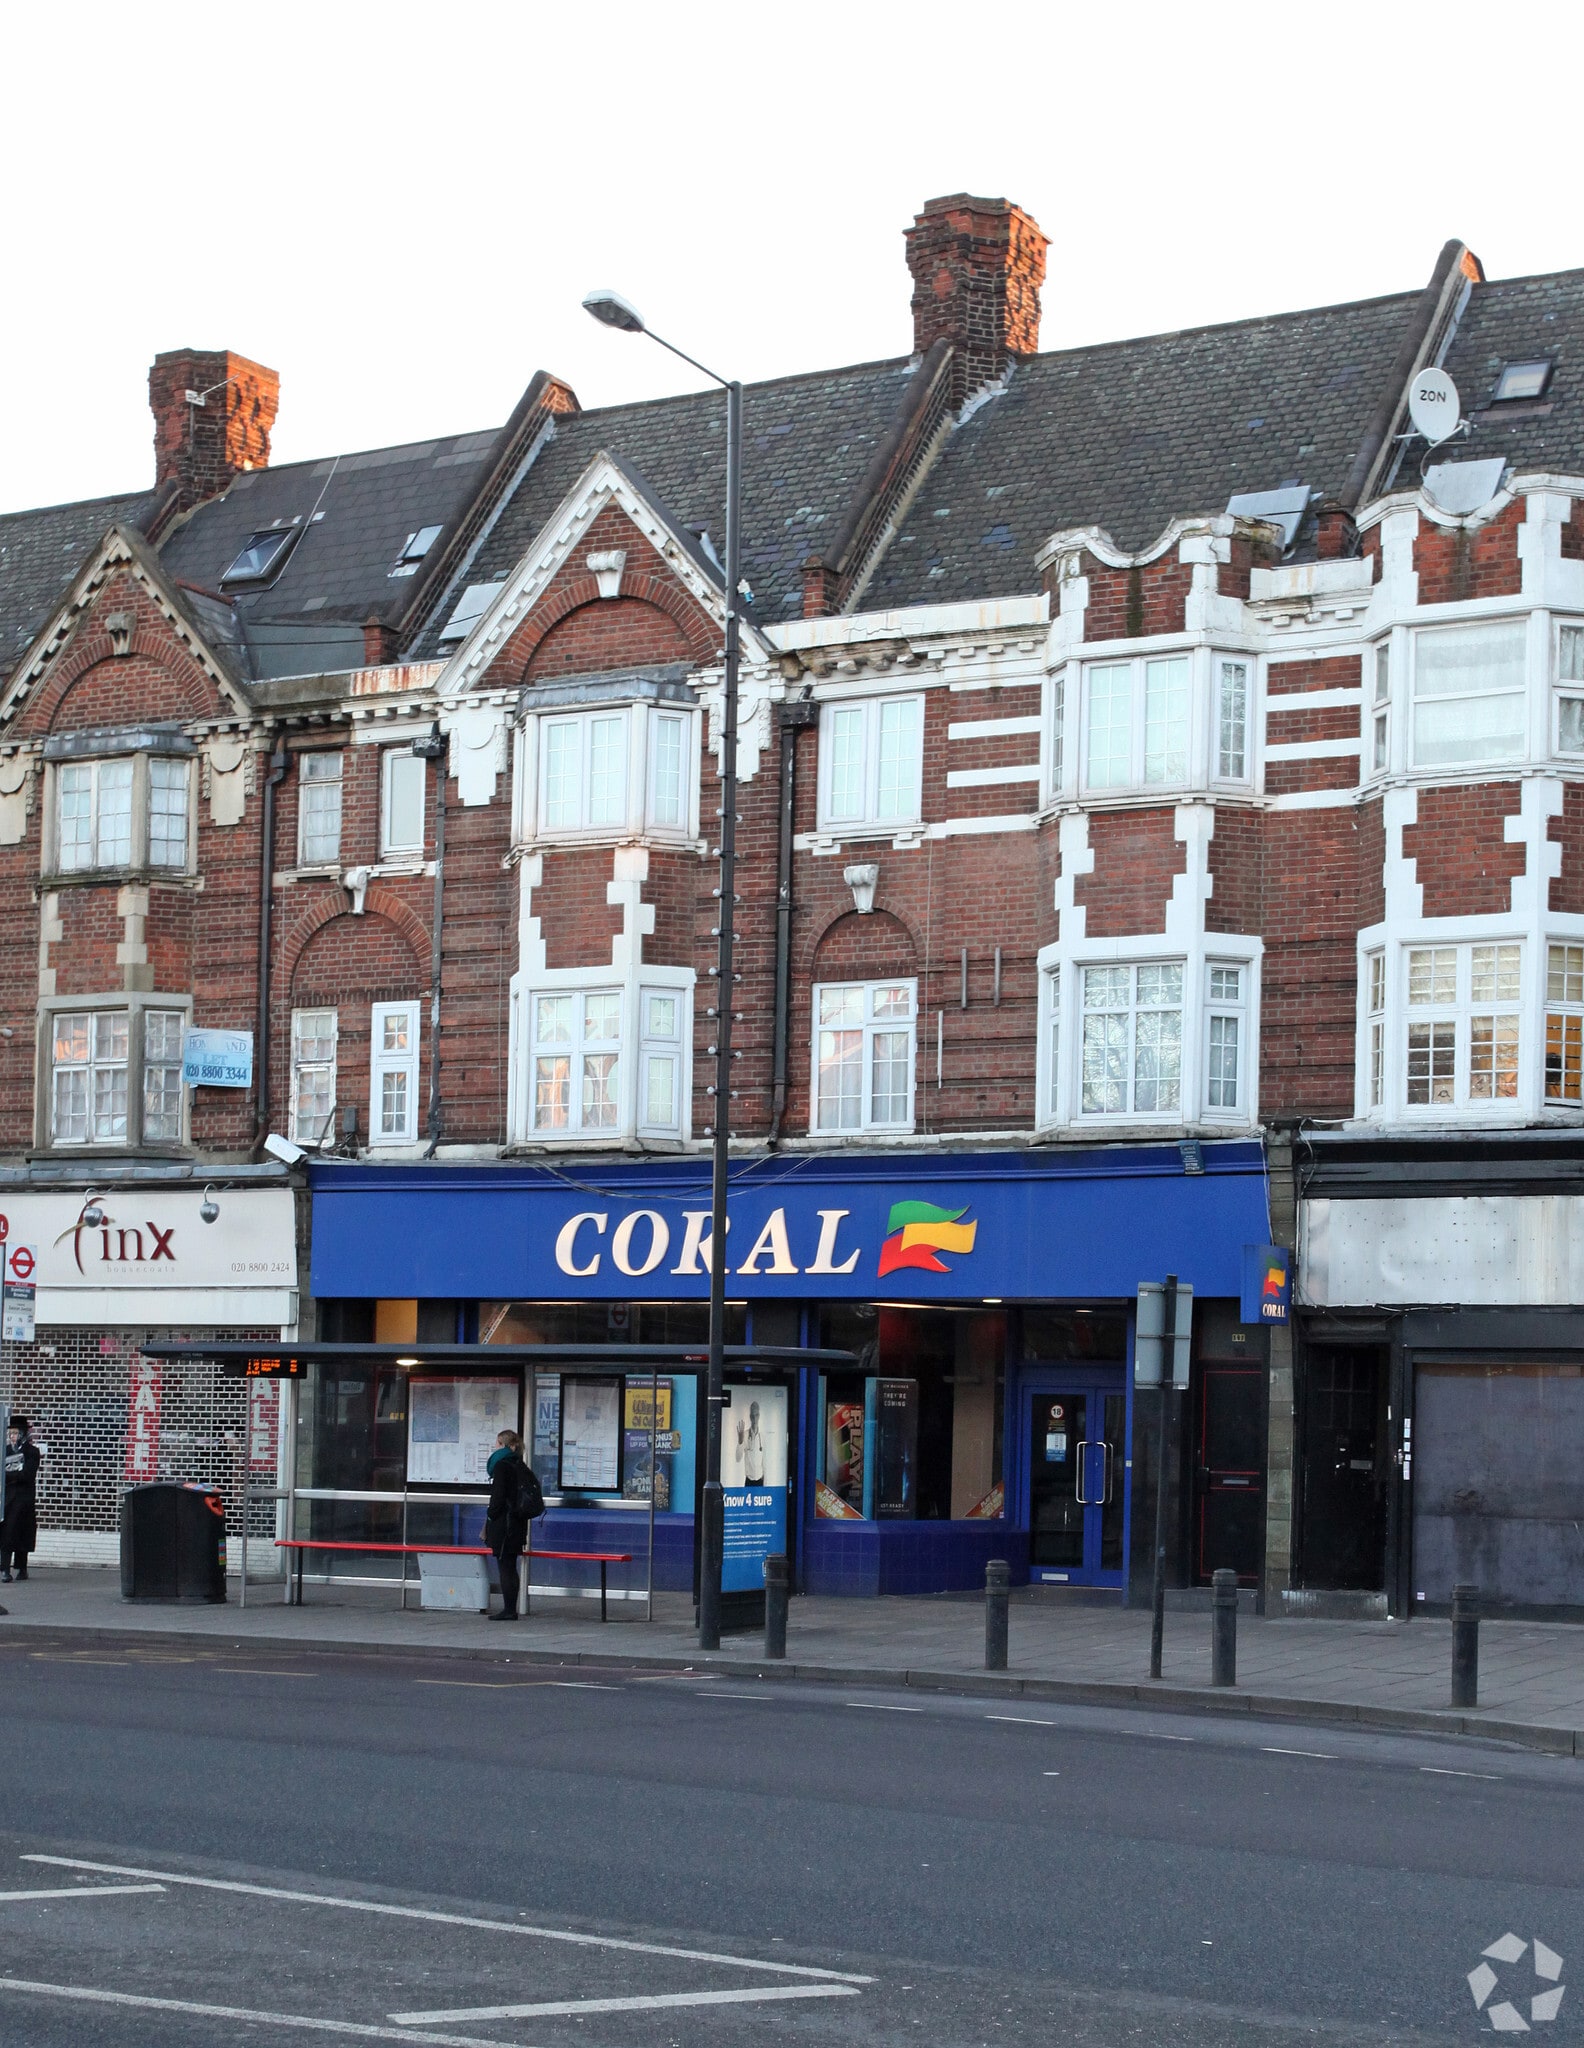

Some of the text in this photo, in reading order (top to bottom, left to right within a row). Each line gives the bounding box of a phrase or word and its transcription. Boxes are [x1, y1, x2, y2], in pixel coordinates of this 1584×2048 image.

[1420, 389, 1446, 402] ZON
[201, 1066, 222, 1079] 8800
[226, 1067, 247, 1080] 3344
[555, 1207, 861, 1277] CORAL
[107, 1264, 175, 1273] housecoats
[231, 1262, 290, 1272] 020 8800 2424
[1262, 1303, 1286, 1318] CORAL
[539, 1402, 560, 1420] NE
[251, 1378, 274, 1460] ALE
[723, 1493, 772, 1507] Know 4 sure
